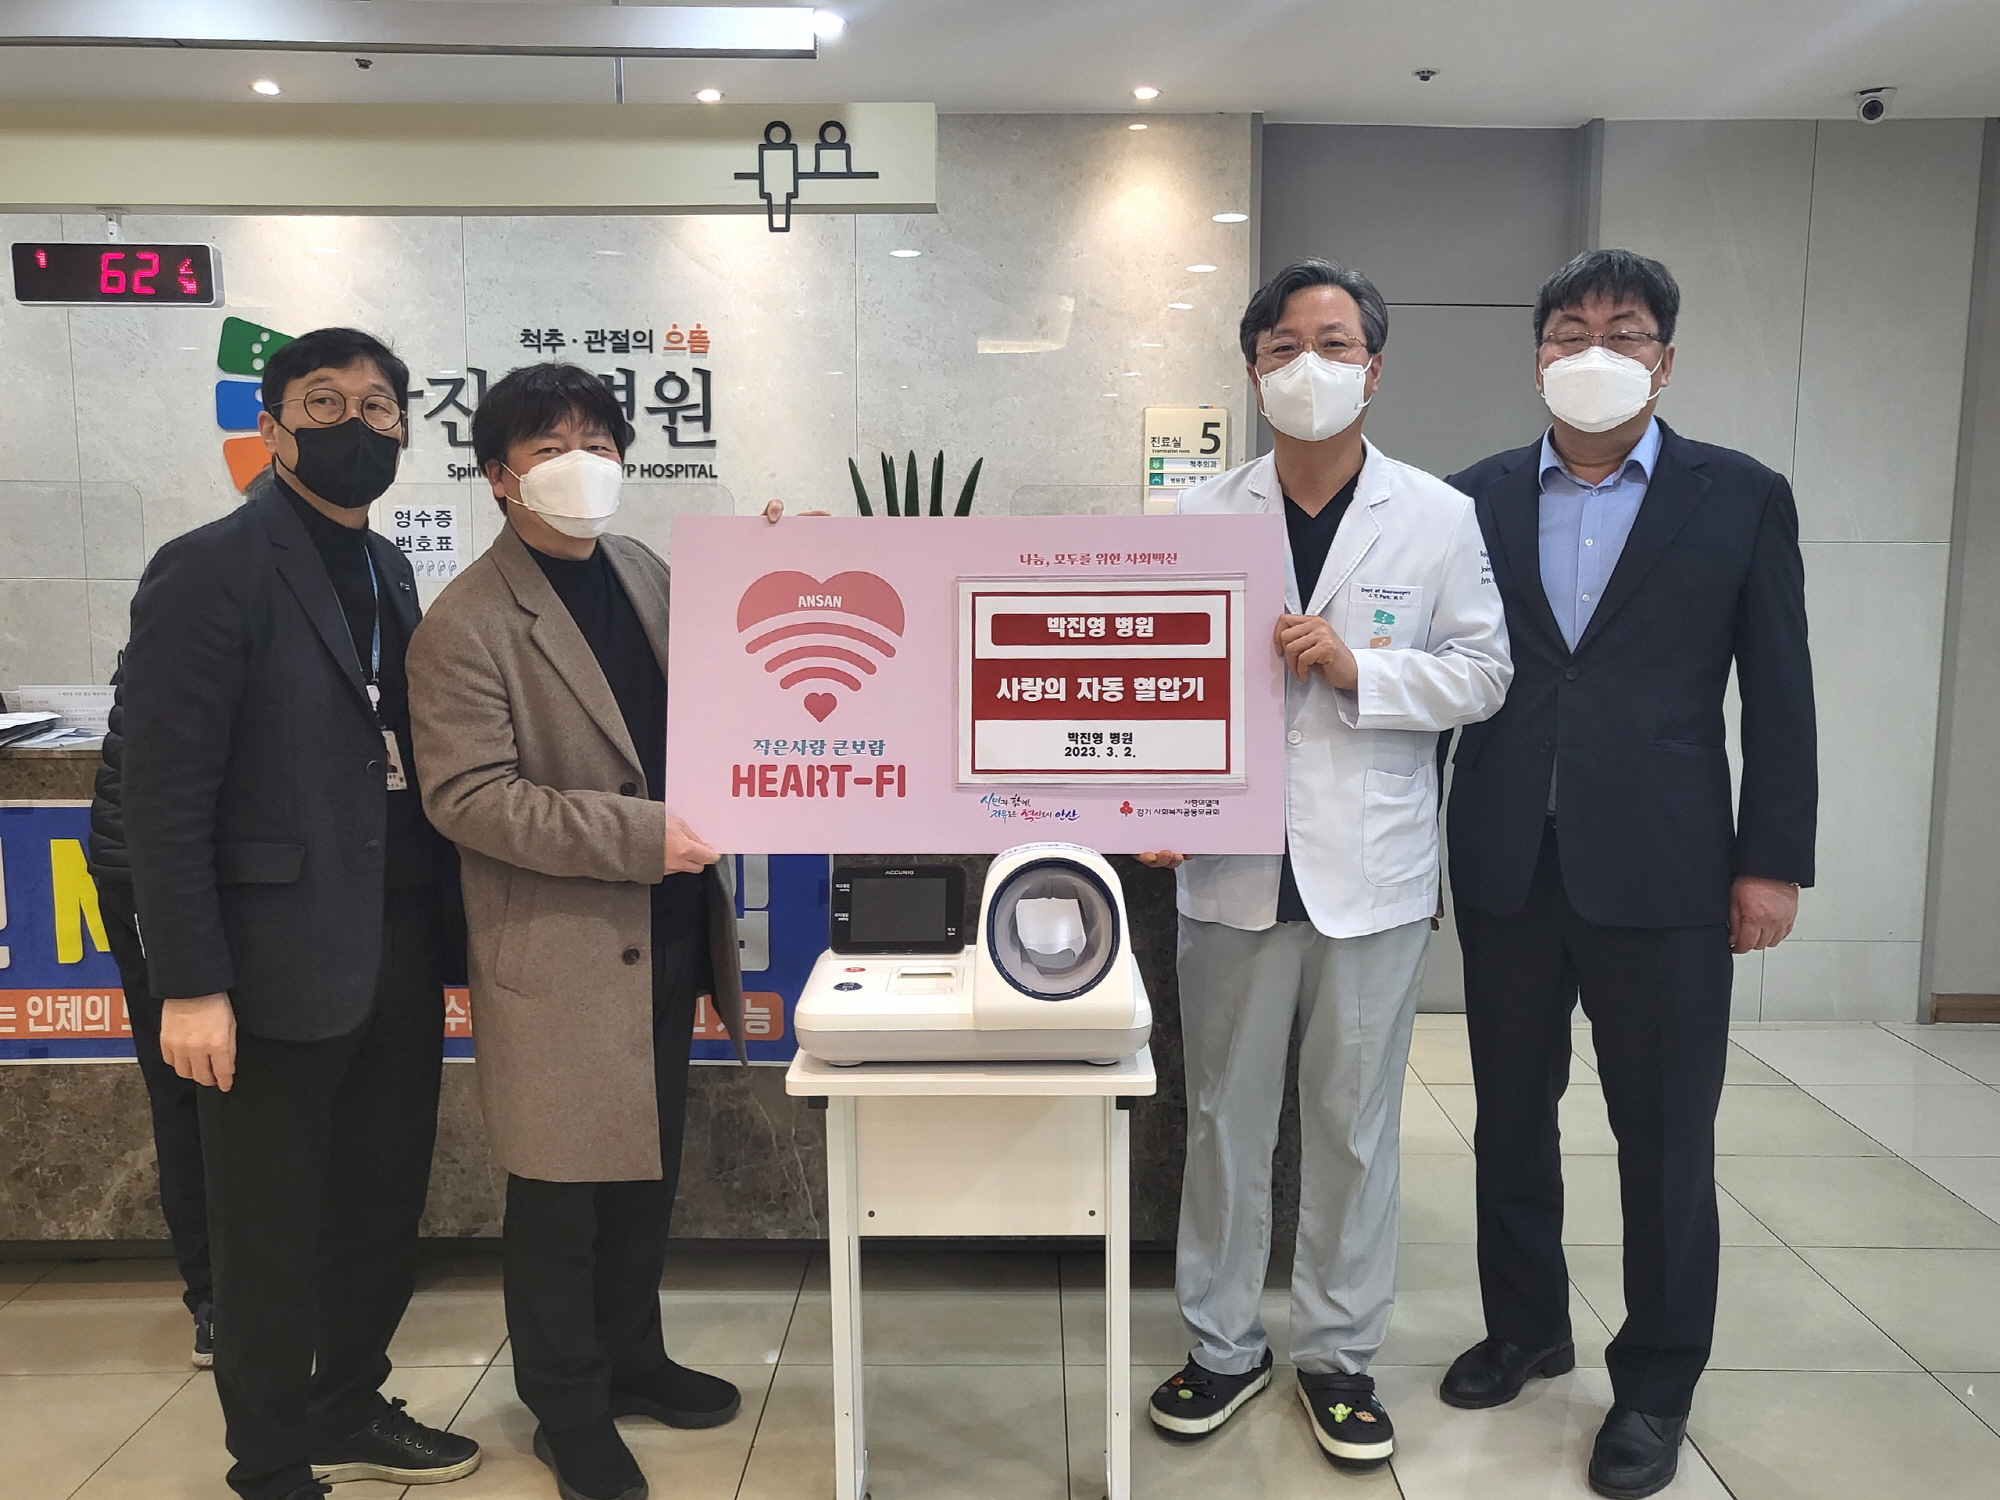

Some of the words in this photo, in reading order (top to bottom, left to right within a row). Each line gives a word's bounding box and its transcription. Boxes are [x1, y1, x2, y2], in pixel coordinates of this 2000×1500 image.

[100, 253, 160, 294] 62
[520, 329, 566, 353] 척추
[583, 328, 654, 353] 관절의
[663, 323, 710, 353] 으뜸
[1150, 436, 1182, 448] 진료실
[1200, 422, 1220, 454] 5
[447, 463, 482, 482] Spin
[640, 463, 718, 479] HOSPITAL
[1189, 476, 1197, 484] 박
[394, 509, 453, 529] 영수증
[395, 535, 454, 553] 번호표
[1019, 553, 1050, 568] 나눔,
[1053, 553, 1092, 566] 모두를
[1095, 553, 1121, 566] 위한
[1124, 552, 1178, 566] 사회백신
[797, 594, 843, 609] ANSAN
[1046, 616, 1106, 638] 박진영
[1114, 616, 1154, 638] 병원
[996, 676, 1067, 702] 사랑의
[1076, 676, 1125, 702] 자동
[1133, 676, 1205, 702] 혈압기
[752, 739, 828, 757] 작은사랑
[831, 739, 886, 757] 큰보람
[1067, 732, 1104, 745] 박진영
[1109, 732, 1134, 745] 병원
[1064, 746, 1101, 758] 2023.
[1106, 746, 1119, 758] 3.
[1123, 746, 1137, 758] 2.
[731, 764, 906, 798] HEART-FI
[1054, 808, 1082, 822] 안산
[26, 995, 111, 1033] 인체의
